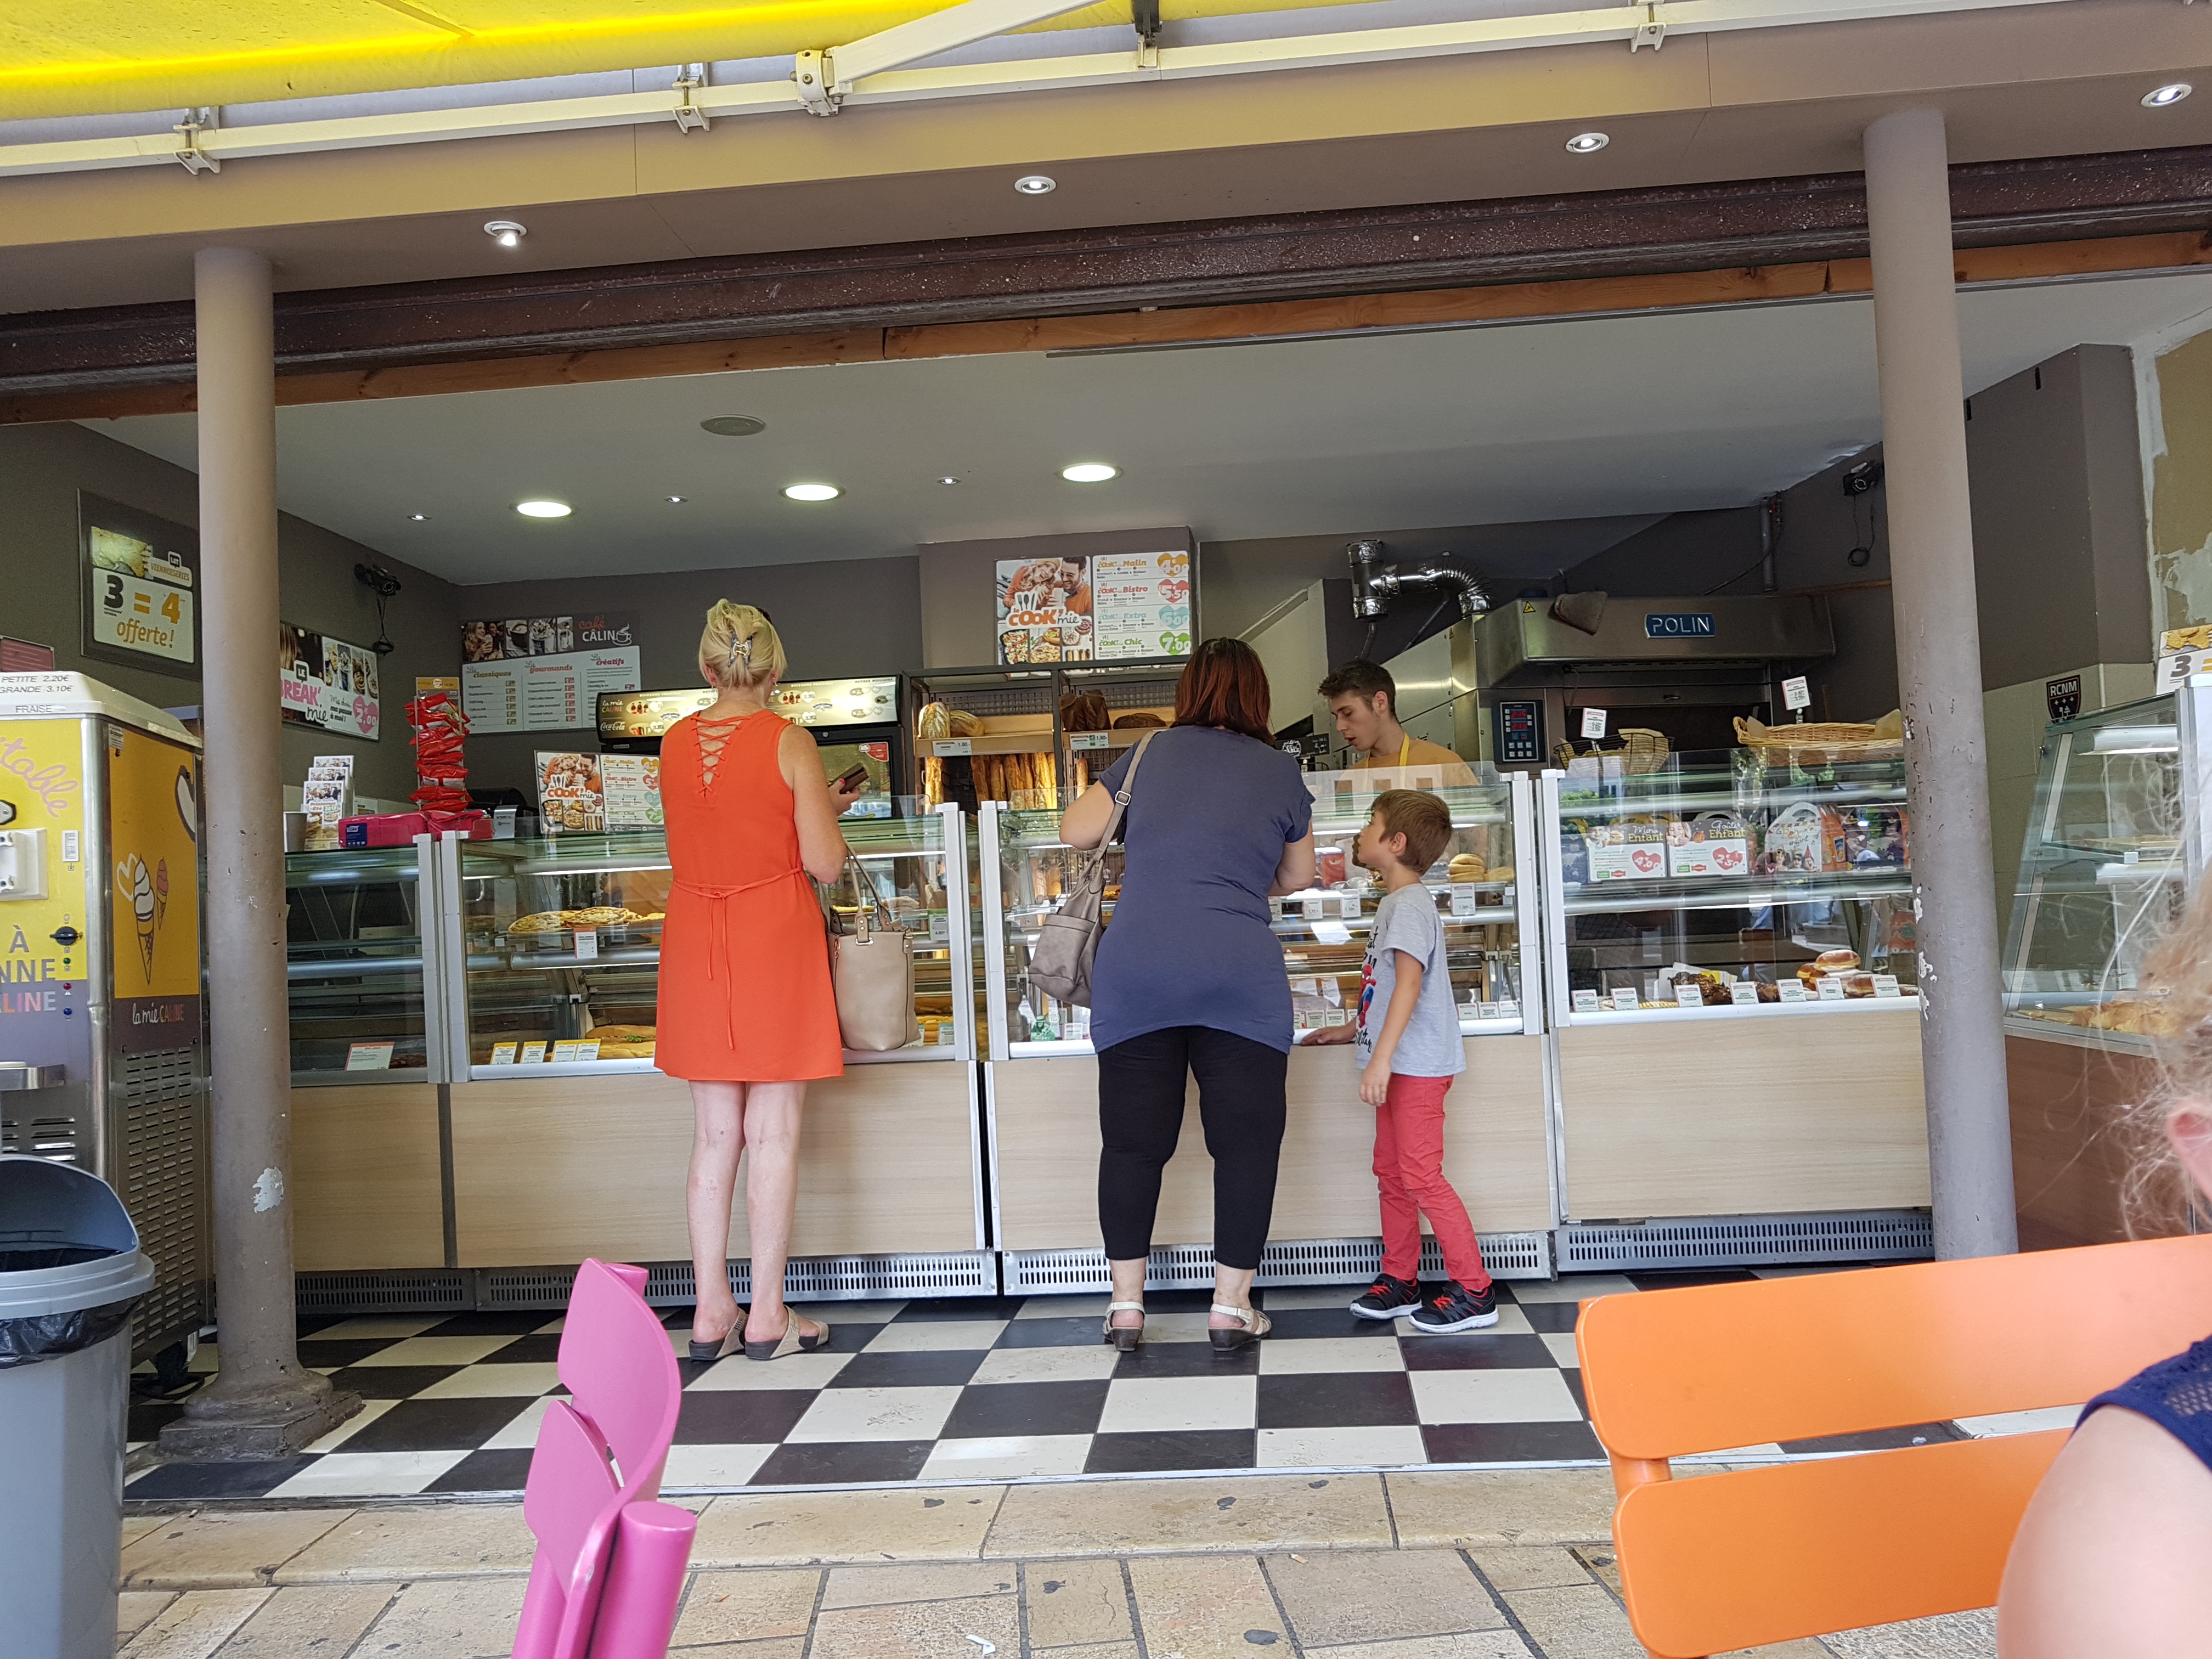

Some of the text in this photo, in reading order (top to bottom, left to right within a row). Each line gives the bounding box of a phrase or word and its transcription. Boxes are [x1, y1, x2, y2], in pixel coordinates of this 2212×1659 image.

[104, 574, 123, 609] 3
[161, 592, 180, 624] 4
[579, 616, 606, 629] café
[1057, 613, 1080, 624] mie
[1652, 617, 1710, 633] POLIN
[582, 629, 616, 642] CÂLIN
[596, 658, 625, 666] créatifs
[2170, 655, 2192, 678] 3
[529, 664, 573, 674] gourmands
[0, 685, 42, 693] GRANDE
[2050, 680, 2078, 697] RCNM
[15, 704, 53, 713] FRAISE
[307, 703, 329, 722] mie
[580, 790, 595, 799] mie
[1628, 831, 1664, 842] Enfant
[1709, 827, 1746, 839] Enfant
[9, 924, 30, 953] À
[0, 991, 57, 1014] LINE
[132, 1002, 142, 1025] la
[142, 1002, 160, 1024] mie
